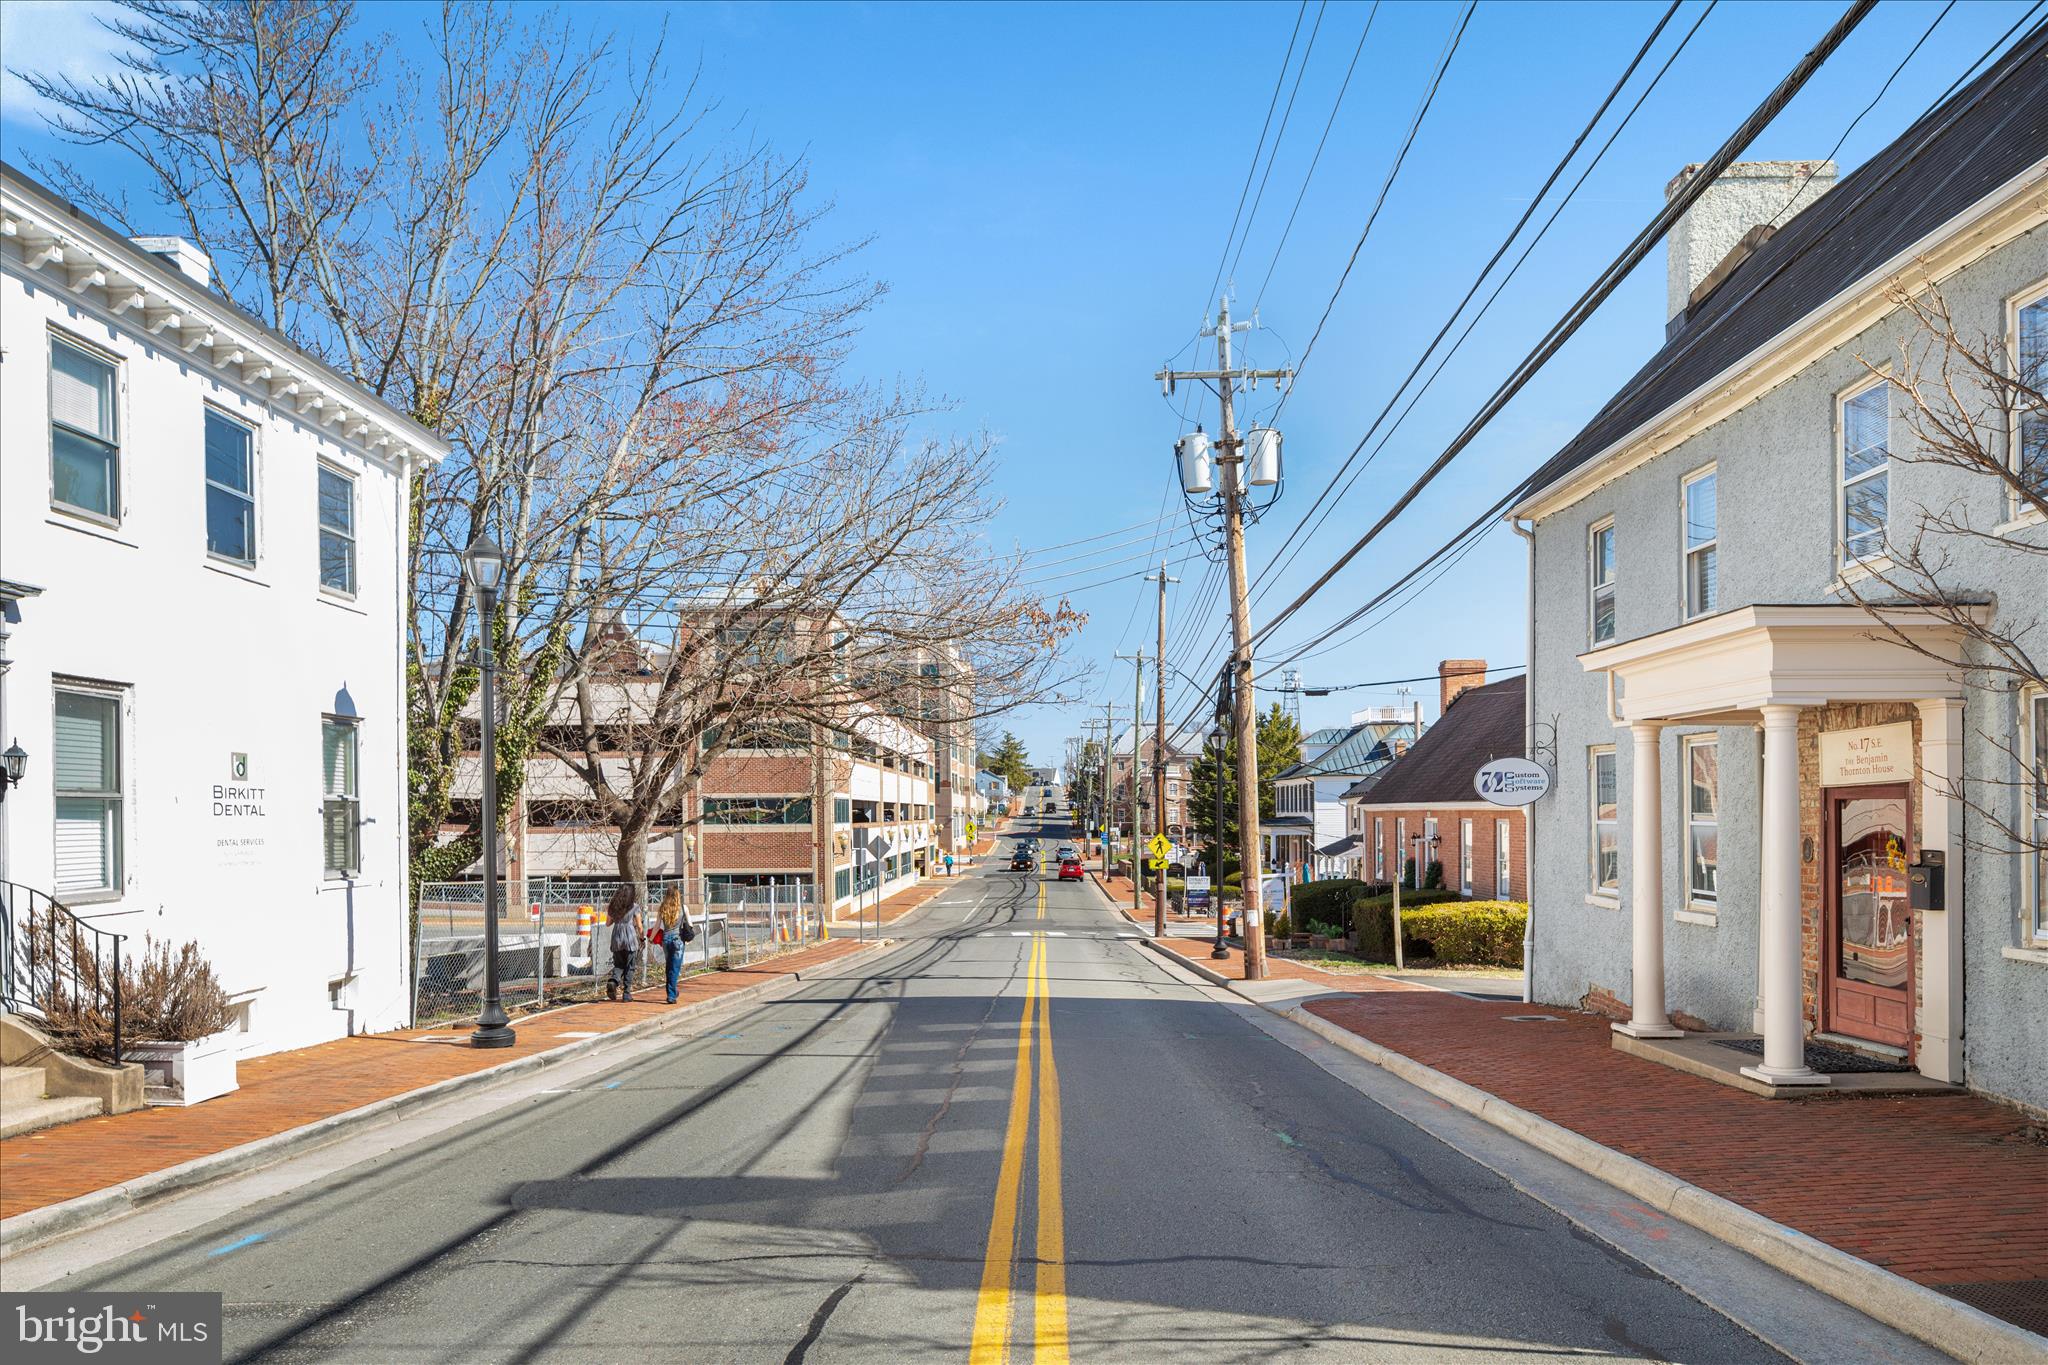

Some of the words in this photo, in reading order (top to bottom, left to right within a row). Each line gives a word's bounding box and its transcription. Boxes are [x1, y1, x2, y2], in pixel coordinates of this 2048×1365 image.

[1860, 737, 1870, 753] 17
[1856, 753, 1888, 766] Benjamin
[1504, 771, 1540, 780] Custom
[1840, 766, 1871, 777] Thornton
[1872, 764, 1894, 775] House
[213, 785, 265, 800] BIRKITT
[1504, 784, 1544, 793] Systems
[213, 802, 266, 817] DENTAL
[216, 839, 239, 847] DENTAL
[240, 838, 265, 846] SERVICES
